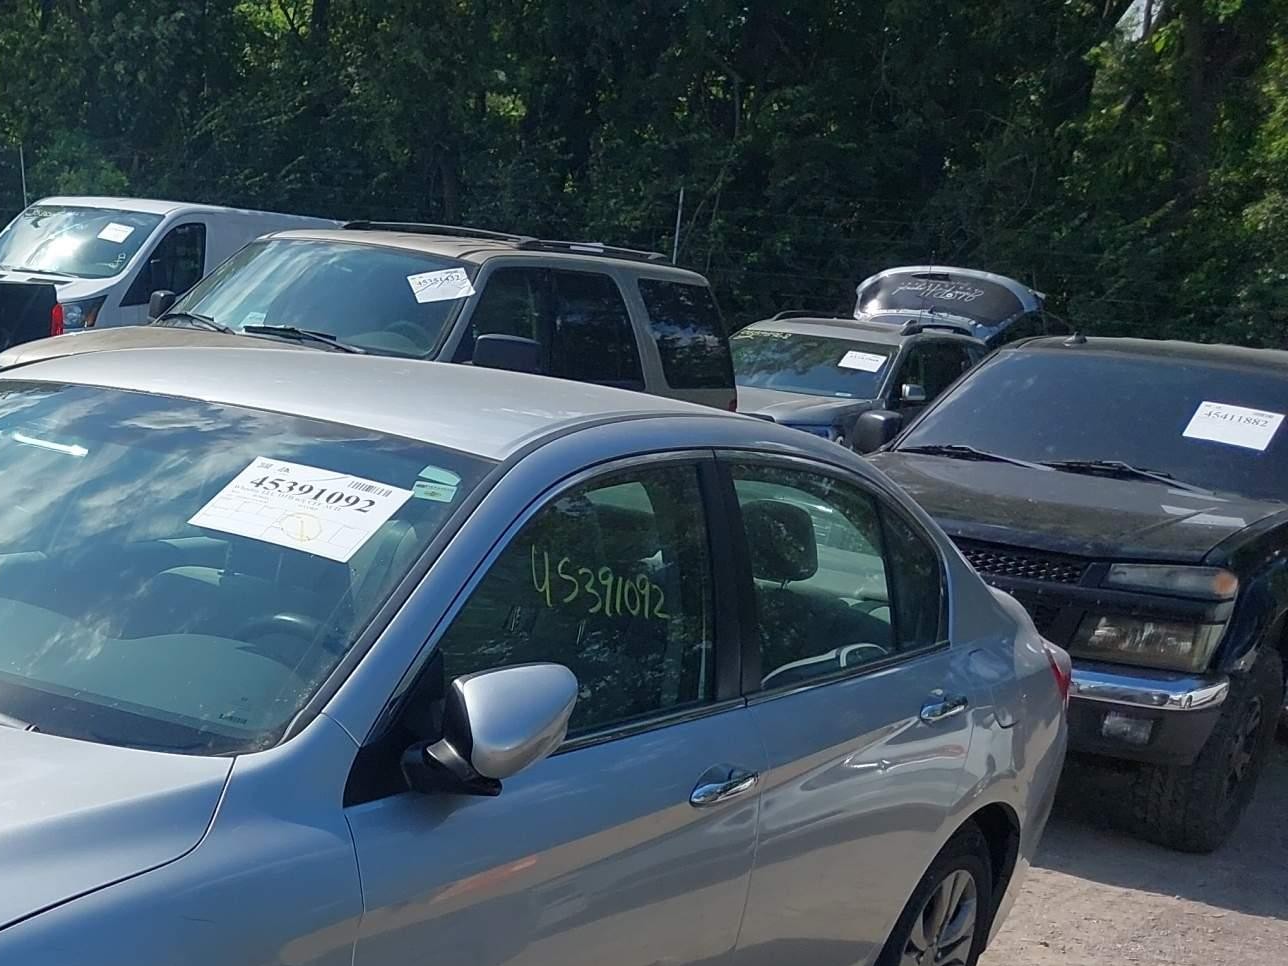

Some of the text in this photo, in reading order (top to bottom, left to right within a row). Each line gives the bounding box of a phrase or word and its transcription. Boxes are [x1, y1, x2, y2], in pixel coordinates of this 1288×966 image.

[1203, 410, 1269, 428] 45411882
[250, 475, 376, 513] 45391092
[532, 544, 671, 619] 45391092
